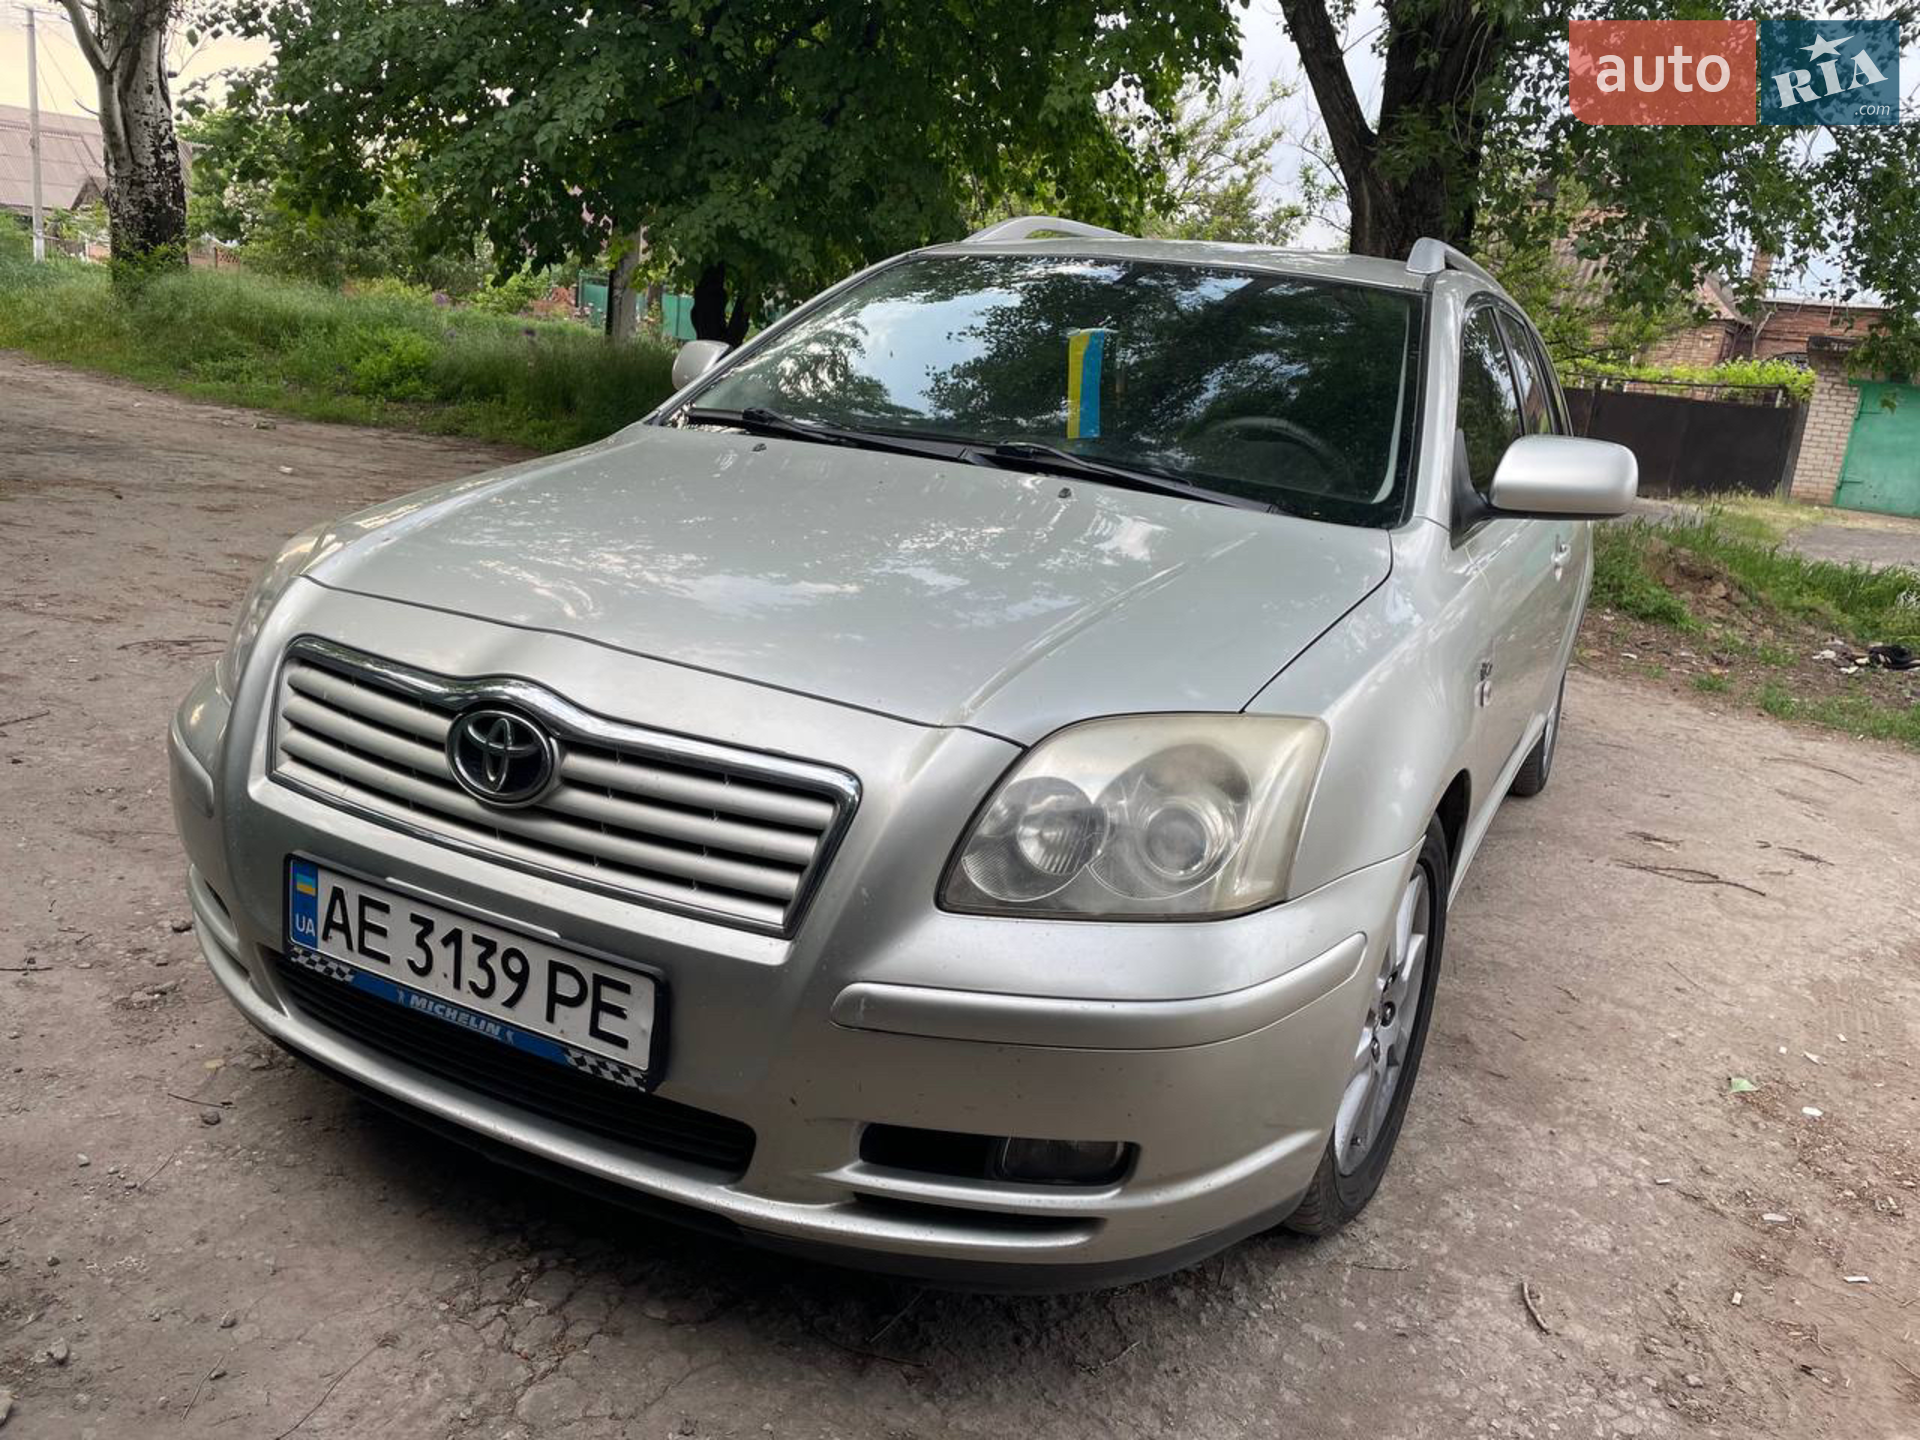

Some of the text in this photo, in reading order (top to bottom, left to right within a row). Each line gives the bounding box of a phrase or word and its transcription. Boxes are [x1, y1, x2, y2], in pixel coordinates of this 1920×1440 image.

[295, 914, 316, 937] UA
[322, 885, 632, 1050] AE 3139 PE
[410, 994, 500, 1036] MICHELIN
